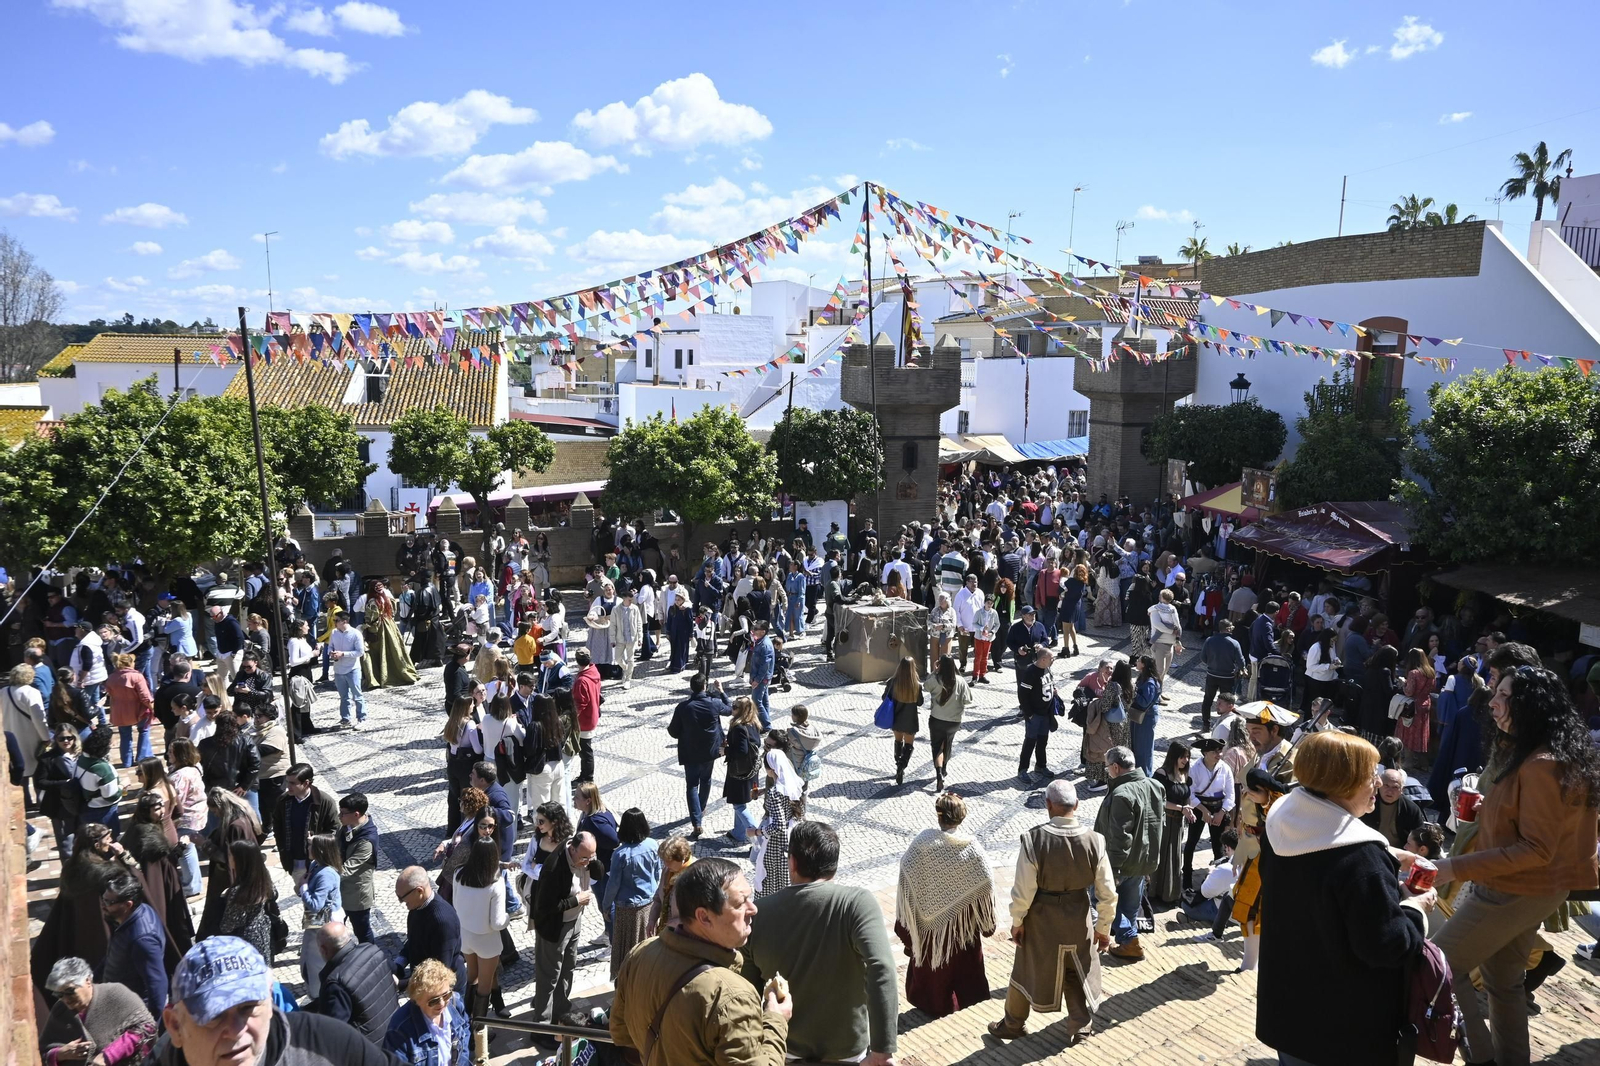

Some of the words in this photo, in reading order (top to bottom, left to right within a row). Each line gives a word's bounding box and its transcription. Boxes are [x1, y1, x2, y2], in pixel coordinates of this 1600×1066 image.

[1136, 919, 1154, 930] NS
[194, 963, 213, 984] LAS
[213, 955, 253, 974] VEGAS
